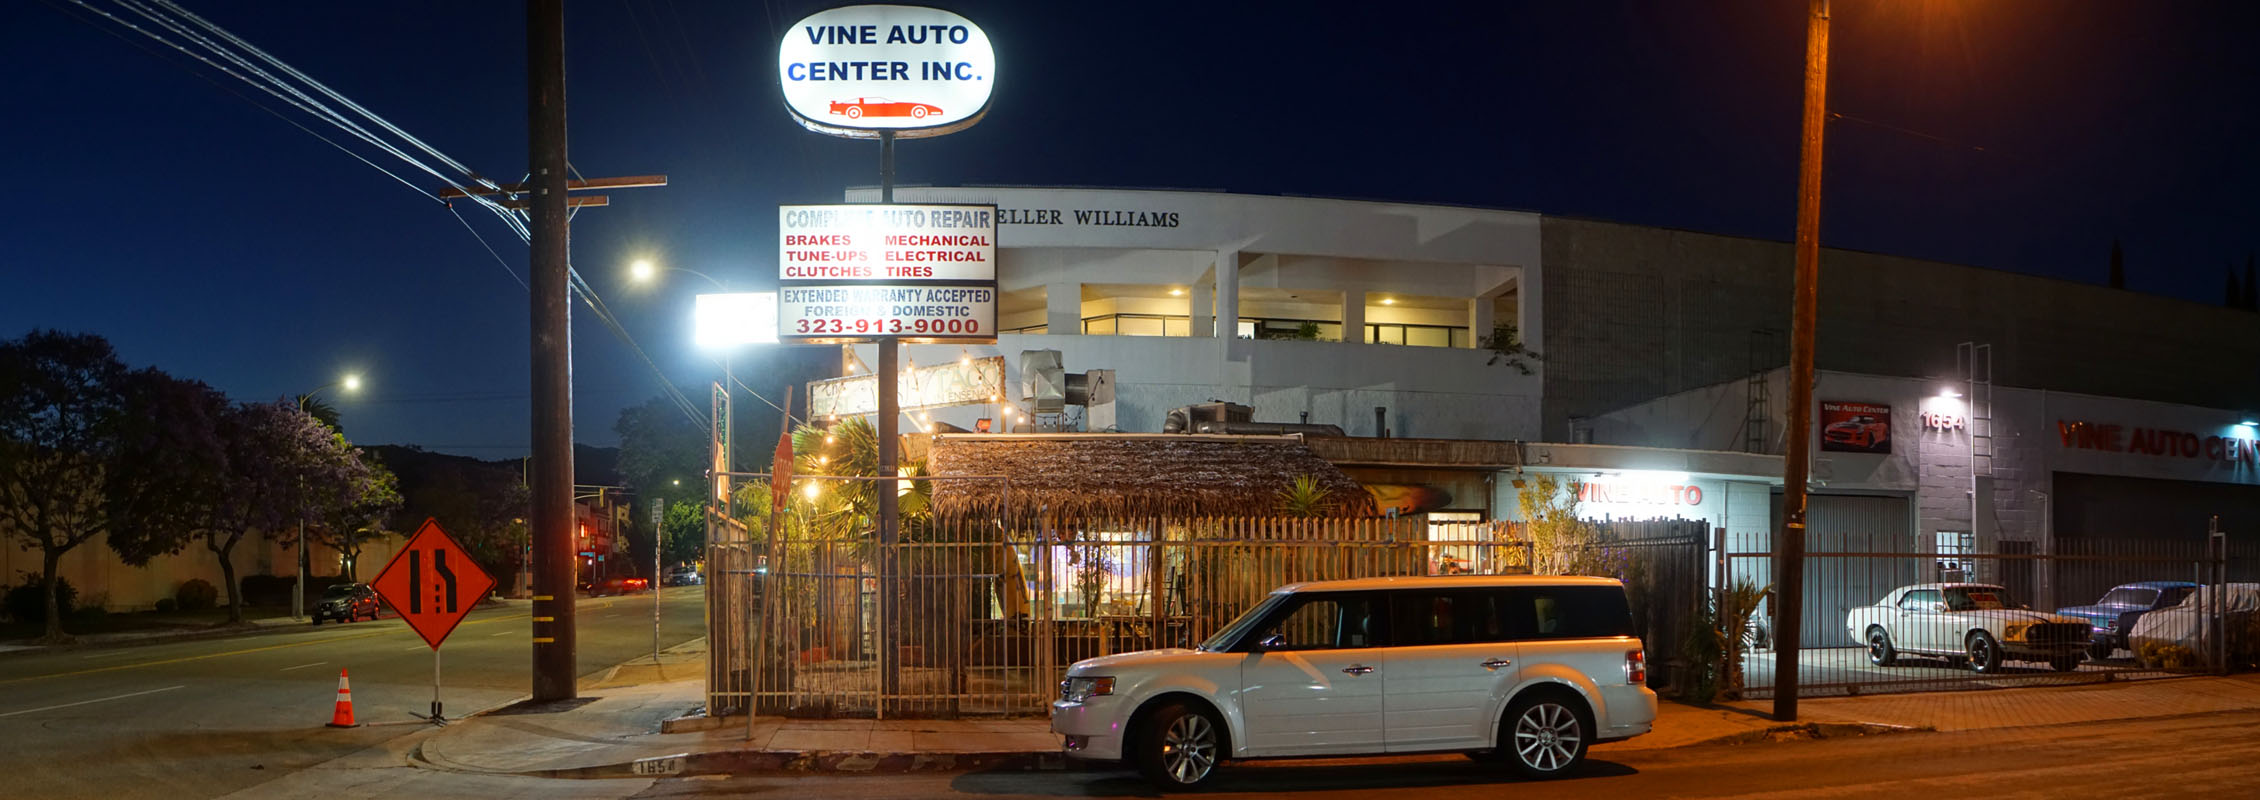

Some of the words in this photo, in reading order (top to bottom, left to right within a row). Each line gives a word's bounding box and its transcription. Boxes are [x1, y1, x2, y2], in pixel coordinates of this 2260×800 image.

[806, 25, 877, 45] VINE
[886, 25, 969, 45] AUTO
[787, 62, 910, 81] CENTER
[922, 62, 983, 81] INC.
[931, 210, 991, 229] REPAIR
[998, 209, 1064, 225] ELLER
[1074, 209, 1180, 228] WILLIAMS
[786, 235, 852, 246] BRAKES
[885, 235, 990, 247] MECHANICAL
[786, 251, 869, 262] TUNE-UPS
[885, 251, 986, 262] ELECTRICAL
[786, 266, 873, 277] CLUTCHES
[886, 266, 933, 277] TIRES
[784, 289, 848, 303] EXTENDED
[926, 289, 991, 303] ACCEPTED
[892, 305, 970, 317] DOMESTIC
[796, 319, 979, 334] 323-913-9000
[1842, 404, 1862, 412] AUTO
[1922, 411, 1965, 430] 1654
[2057, 420, 2122, 451] VINE
[2128, 427, 2199, 459] AUTO
